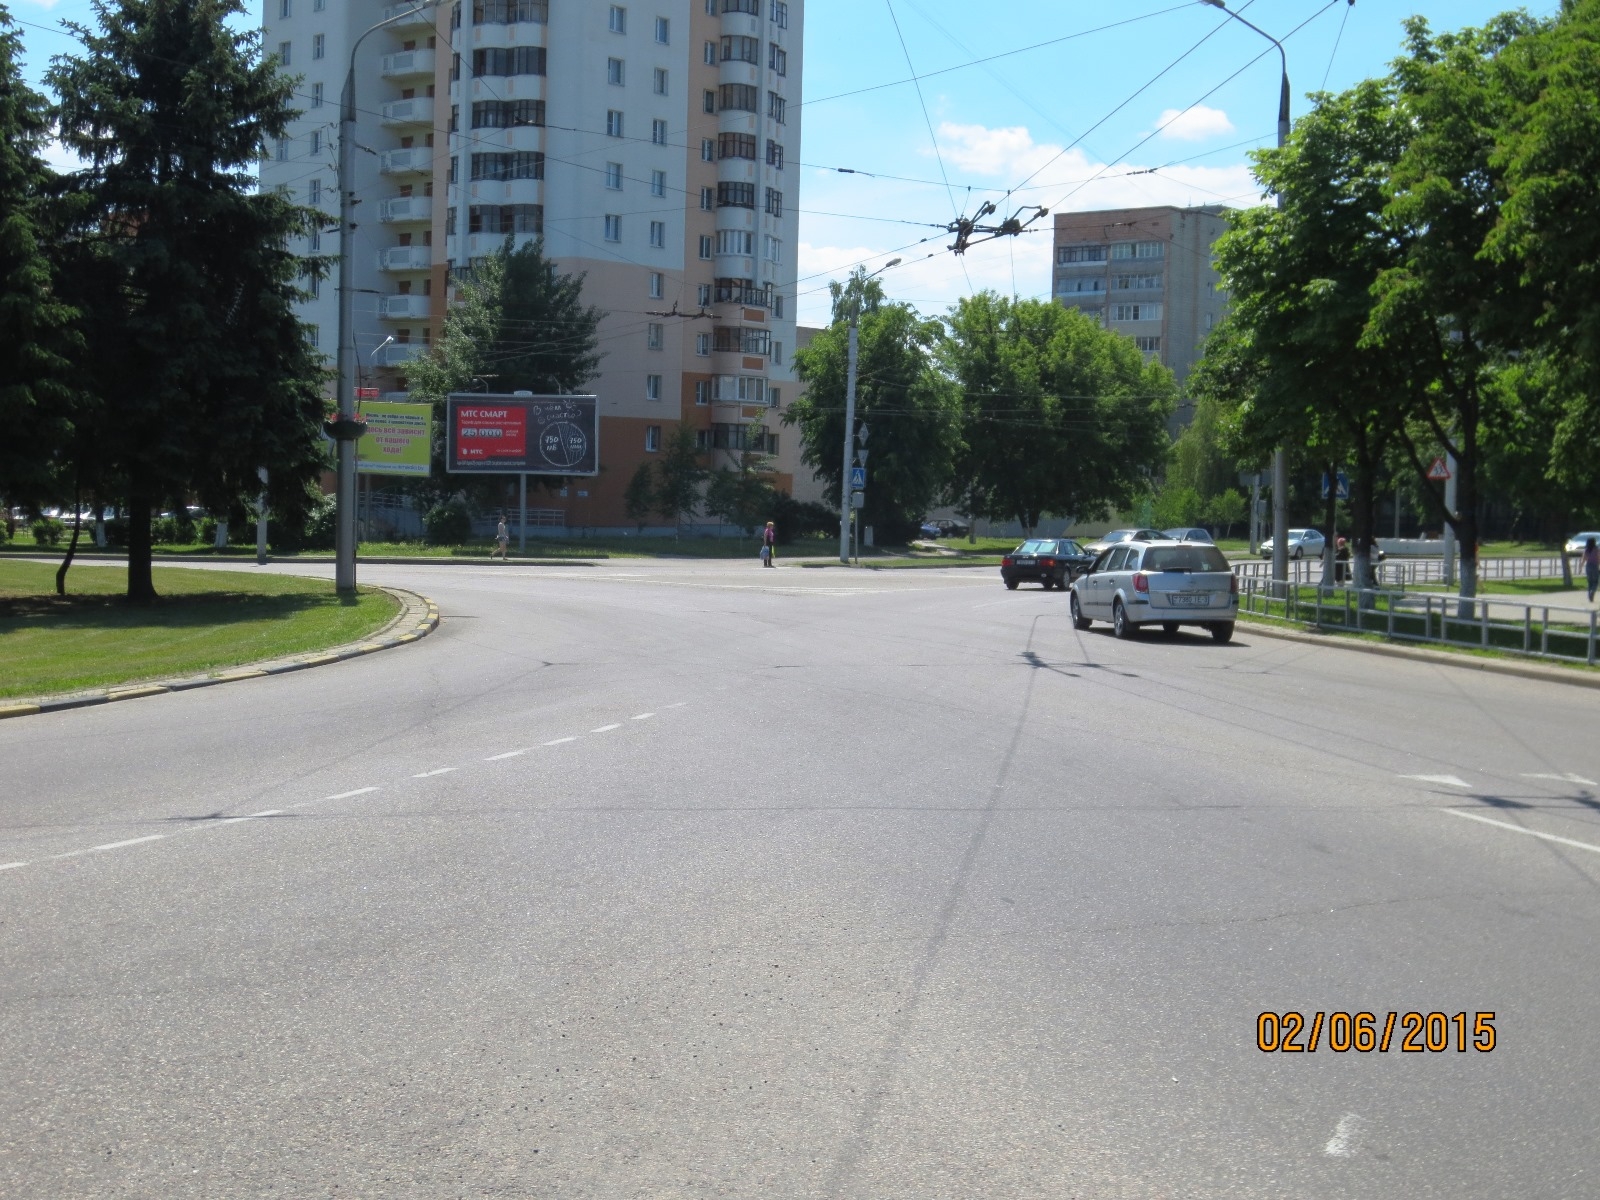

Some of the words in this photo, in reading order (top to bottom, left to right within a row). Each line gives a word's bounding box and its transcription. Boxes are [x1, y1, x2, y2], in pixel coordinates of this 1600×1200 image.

[461, 410, 478, 418] МТС
[480, 410, 507, 418] СМАРТ
[366, 426, 382, 434] десь
[463, 429, 476, 437] 25
[479, 429, 501, 437] 000
